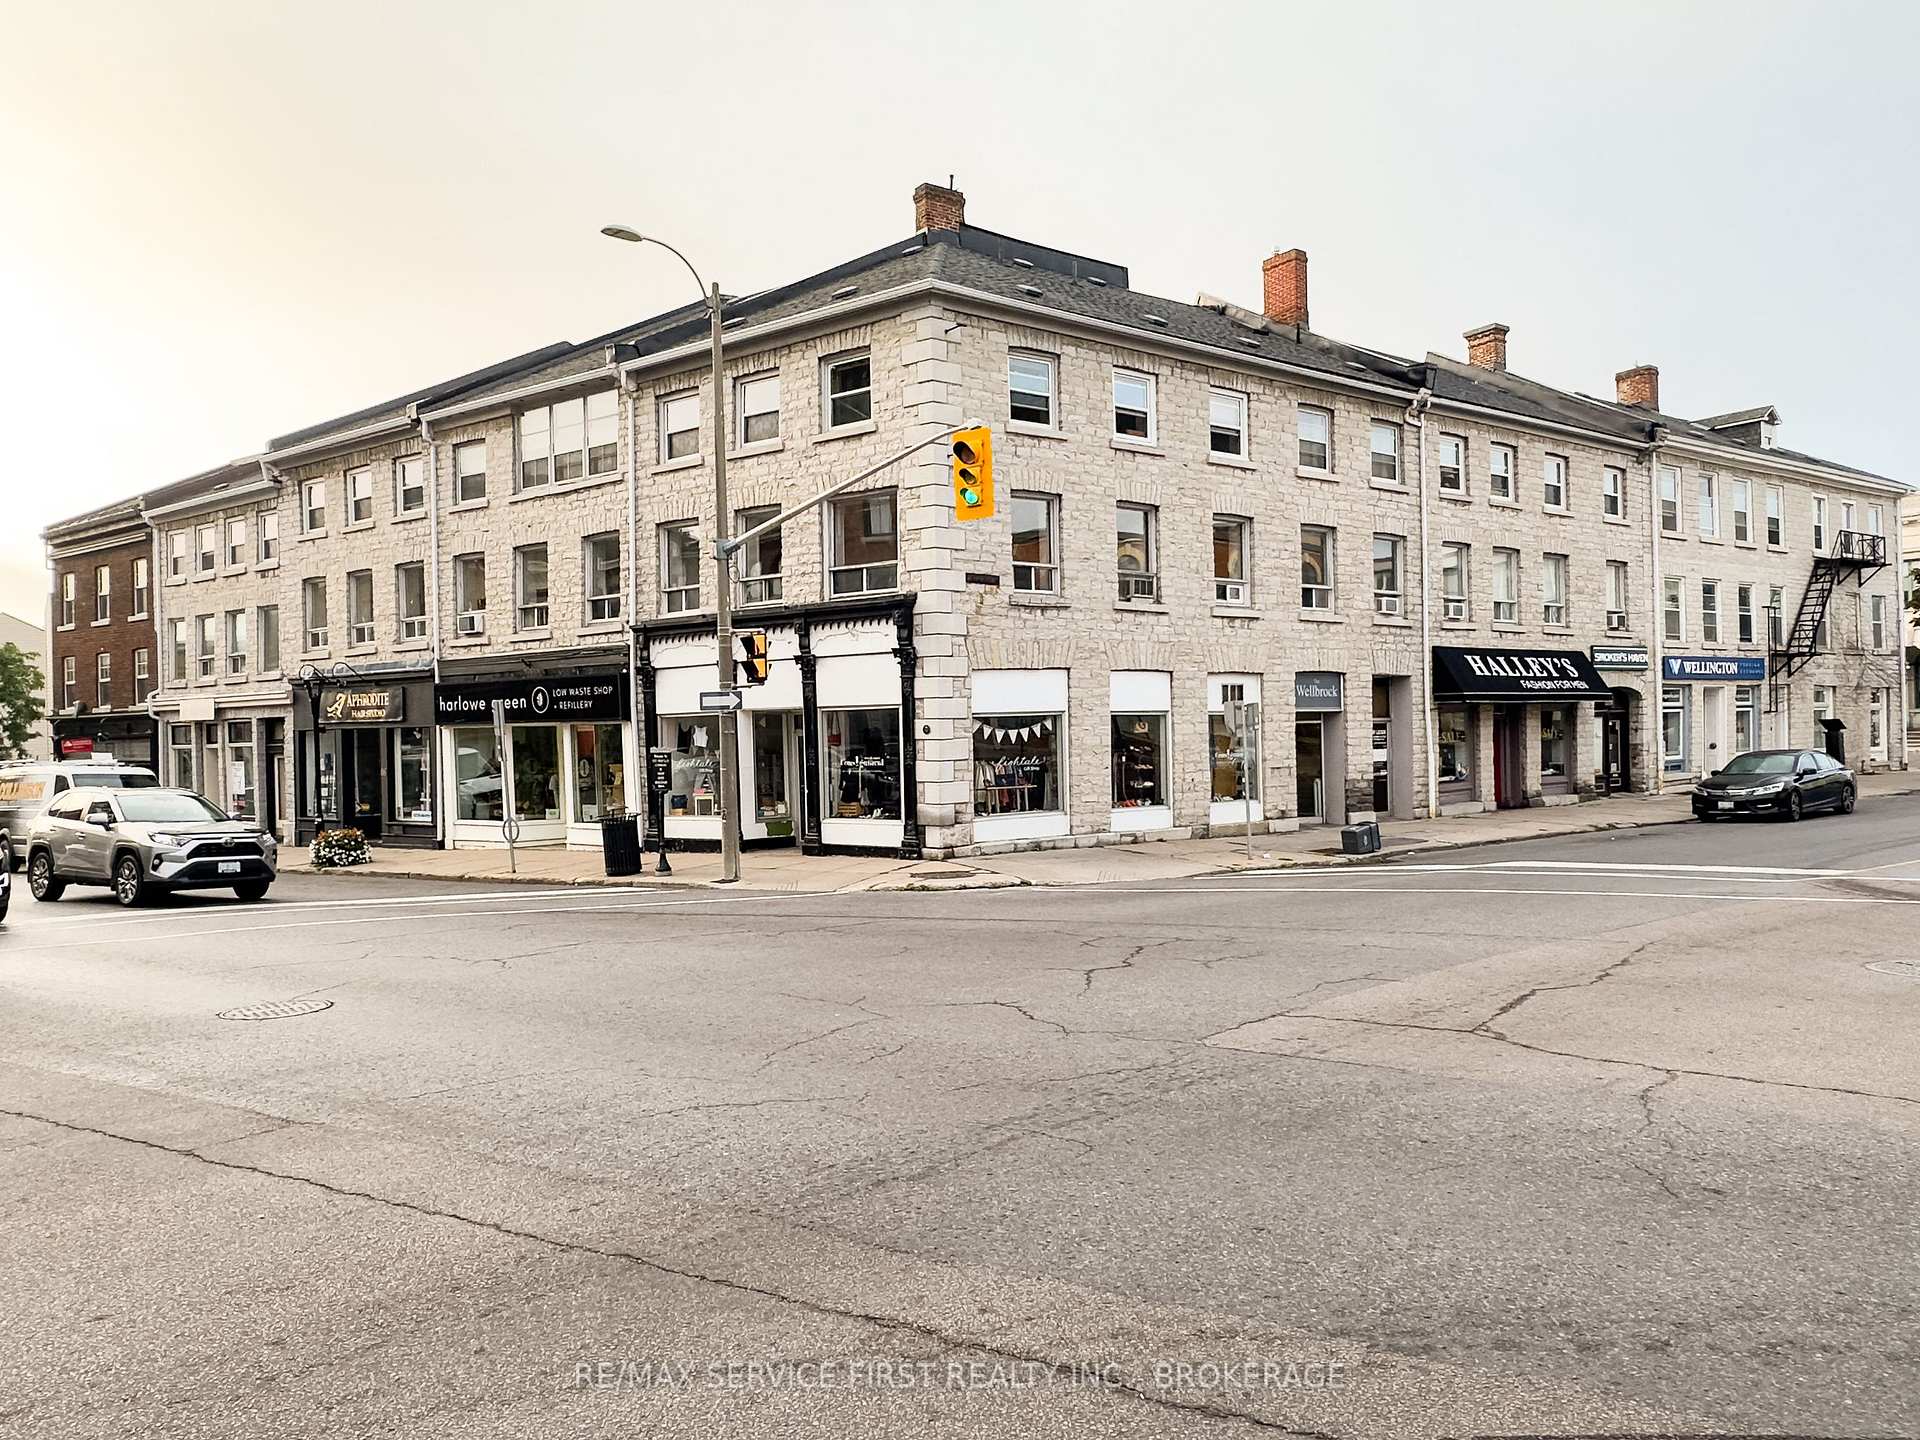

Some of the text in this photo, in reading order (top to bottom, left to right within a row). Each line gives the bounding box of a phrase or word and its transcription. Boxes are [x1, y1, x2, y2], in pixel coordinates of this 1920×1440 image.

[1463, 654, 1579, 678] HALLEY'S
[1683, 661, 1738, 675] WELLINGTON
[552, 685, 613, 697] LOW WASTE SHOP
[1296, 684, 1338, 697] Wellbrock
[1519, 680, 1556, 689] FASHION
[346, 692, 390, 707] APHRODITE
[439, 696, 486, 712] harlowe
